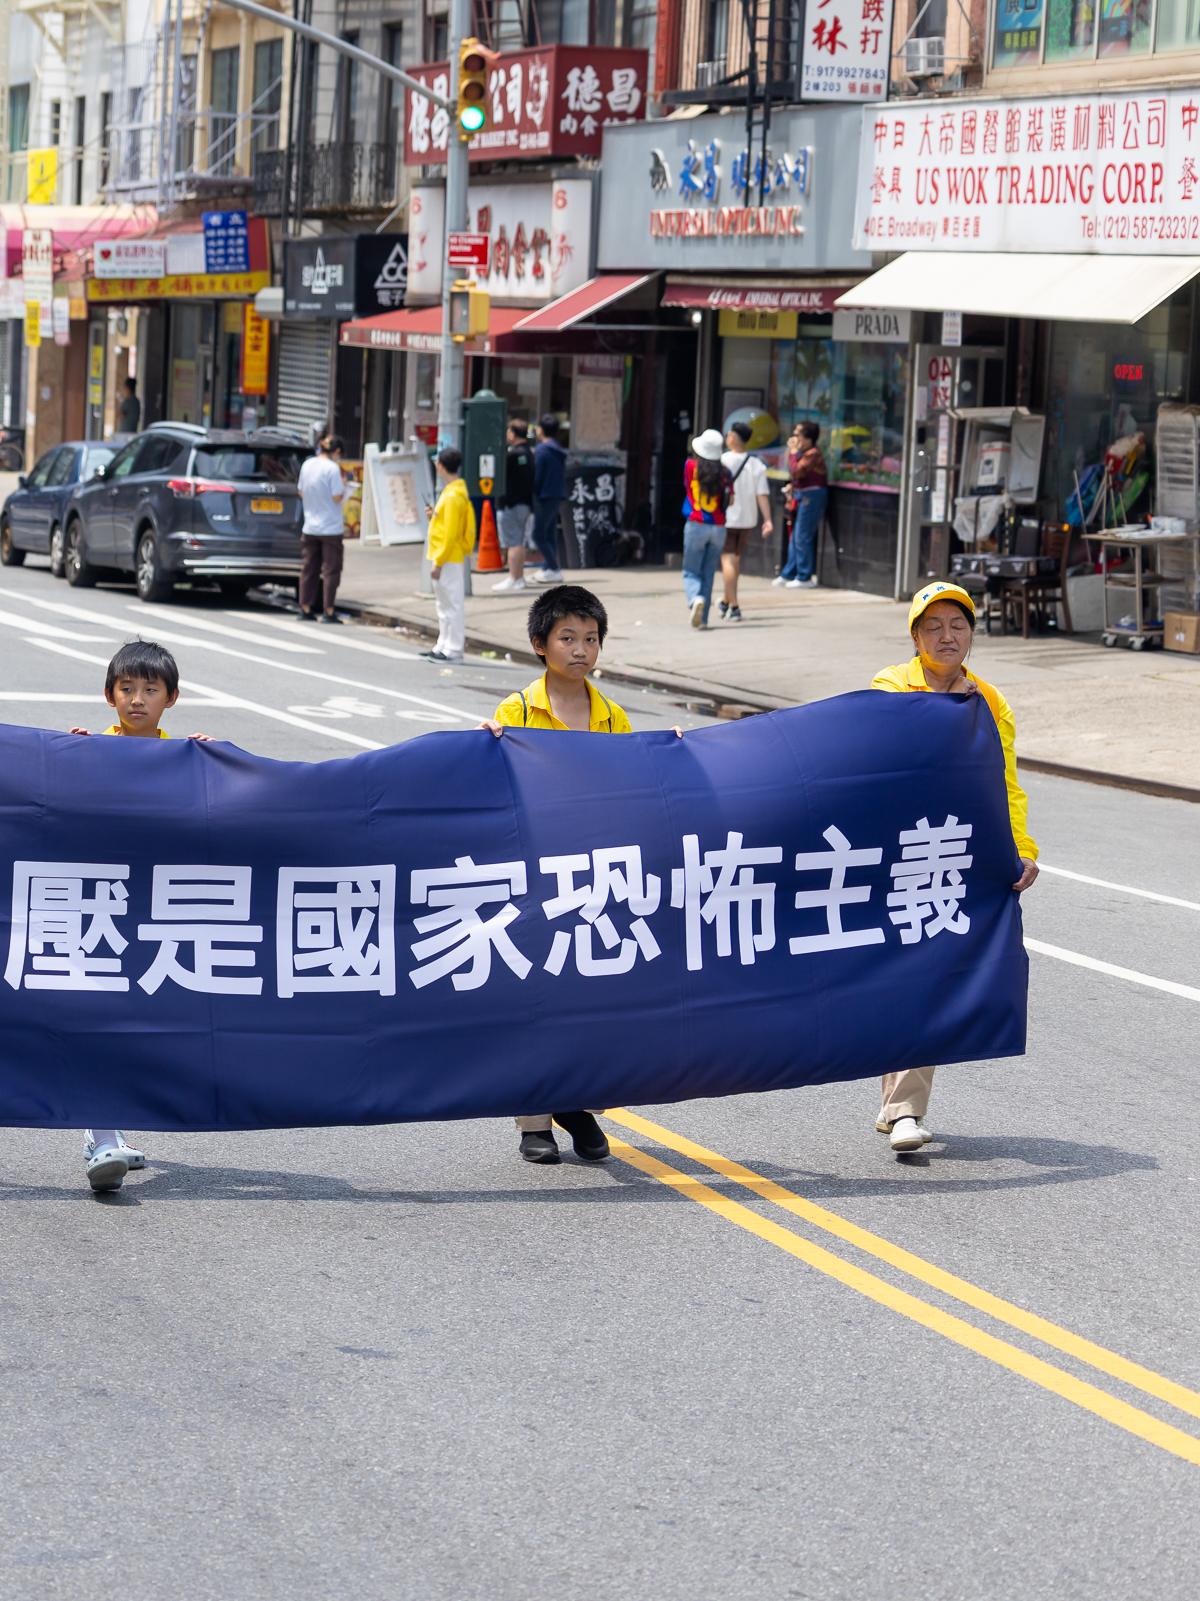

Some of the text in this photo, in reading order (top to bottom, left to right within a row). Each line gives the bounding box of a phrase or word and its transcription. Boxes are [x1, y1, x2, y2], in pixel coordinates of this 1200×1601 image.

[812, 0, 848, 55] 林
[860, 0, 884, 54] 跌打
[562, 64, 642, 115] 德昌
[560, 113, 637, 137] 肉食
[874, 116, 906, 152] 中日
[916, 162, 1164, 205] US WOK TRADING CORP.
[554, 189, 568, 210] 6
[650, 205, 805, 237] UNIVERSAL OPTICAL INC.
[888, 215, 938, 242] Broadway
[1081, 215, 1101, 238] Tel:
[1103, 215, 1131, 240] (212)
[855, 314, 900, 336] PRADA
[1114, 364, 1143, 380] OPEN
[569, 473, 615, 504] 永昌
